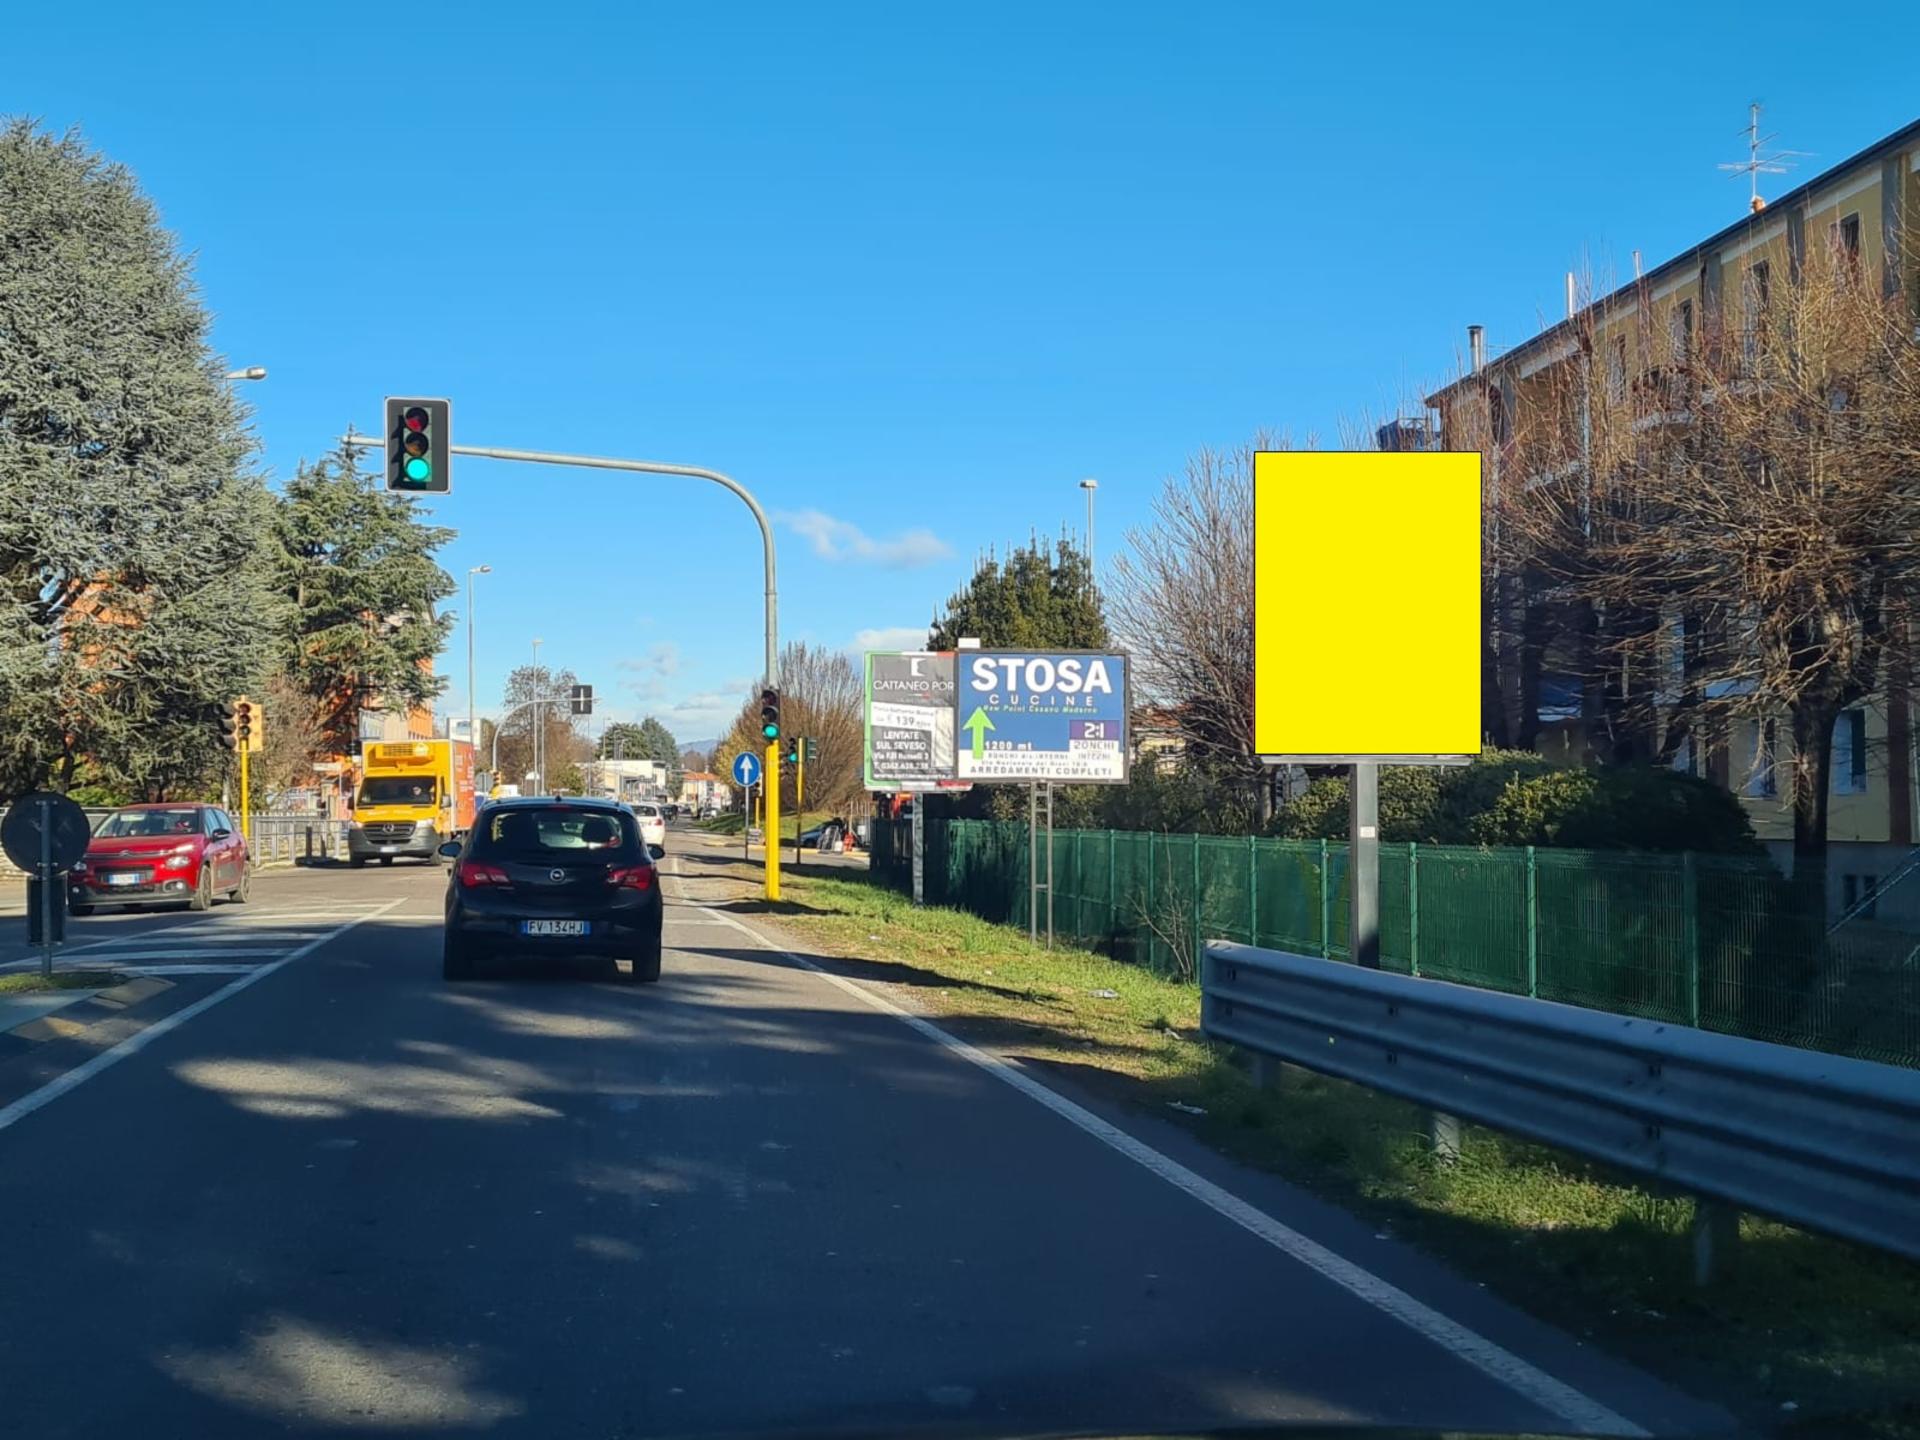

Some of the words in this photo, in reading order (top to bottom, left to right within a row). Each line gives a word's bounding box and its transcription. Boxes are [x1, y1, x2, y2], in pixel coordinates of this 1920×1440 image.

[970, 656, 1113, 694] STOSA
[873, 680, 930, 691] CATTANEO
[988, 694, 1094, 706] CUCINE
[896, 715, 915, 726] 139
[883, 730, 920, 740] LENTATE
[894, 741, 927, 751] SEVESO
[970, 766, 1051, 775] ARREDAMENTI
[1055, 767, 1112, 776] COMPLETI
[529, 920, 543, 933] FV
